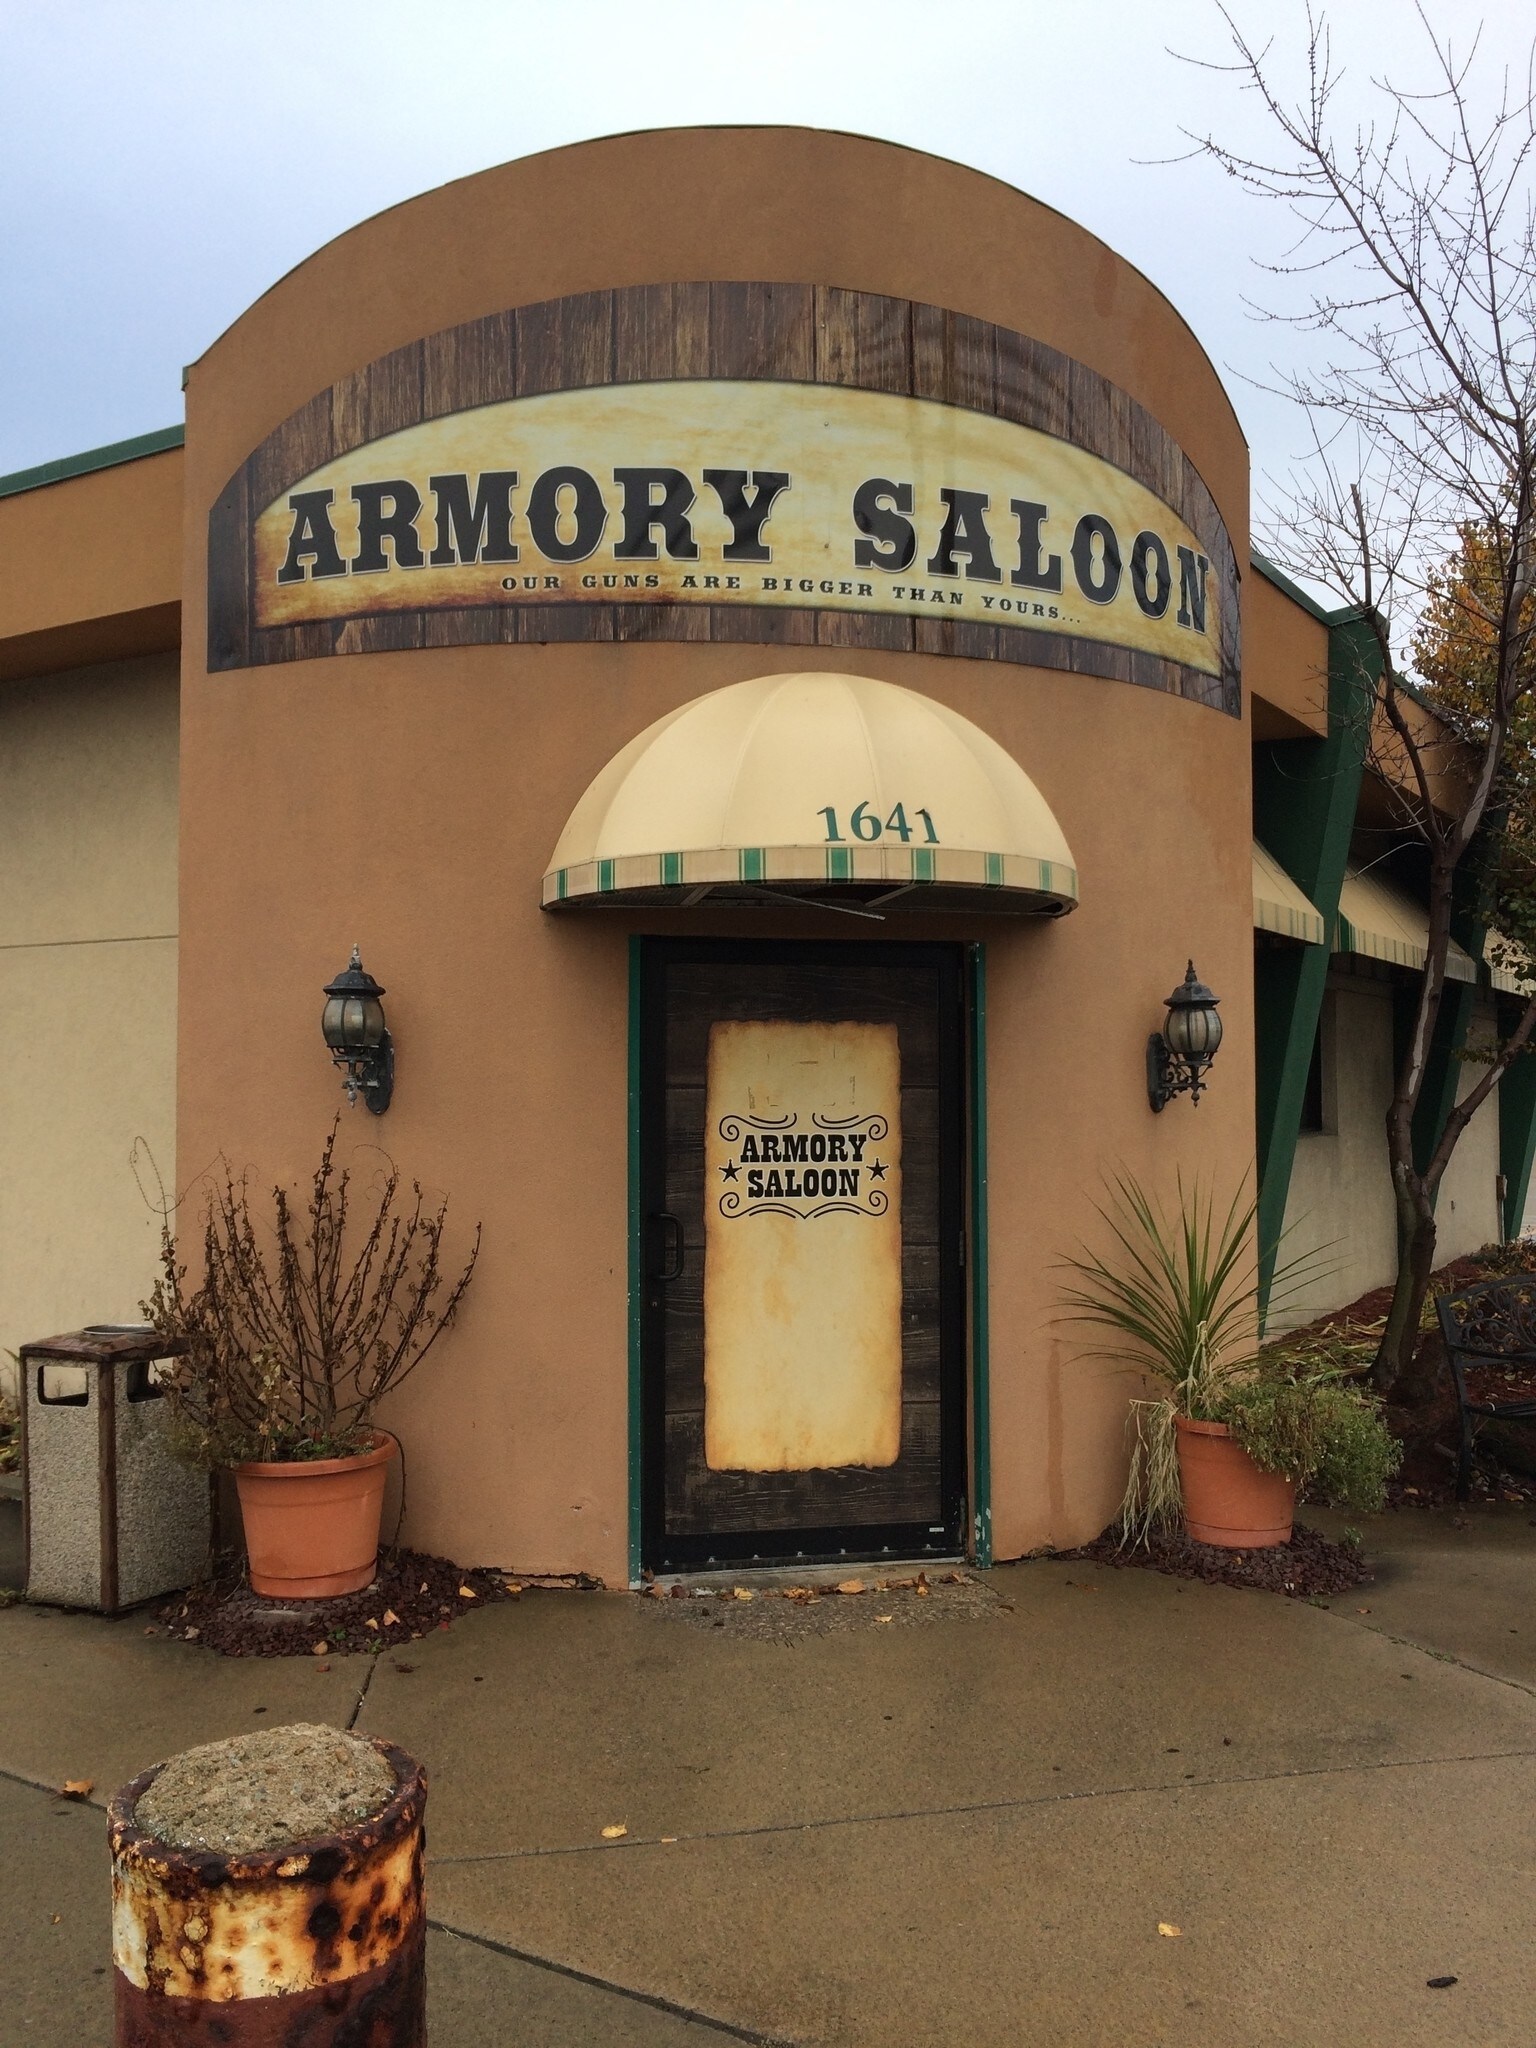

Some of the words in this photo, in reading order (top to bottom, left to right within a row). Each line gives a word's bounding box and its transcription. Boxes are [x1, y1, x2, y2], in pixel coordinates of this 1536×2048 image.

[277, 466, 790, 585] ARMORY
[852, 477, 1209, 634] SALOON
[501, 575, 561, 591] OUR
[581, 574, 660, 589] GUNS
[681, 575, 741, 590] ARE
[761, 577, 874, 597] BIGGER
[892, 586, 964, 605] THAN
[980, 595, 1081, 624] YOURS...
[816, 800, 941, 844] 1641
[740, 1134, 867, 1163] ARMORY
[747, 1168, 860, 1198] SALOON
